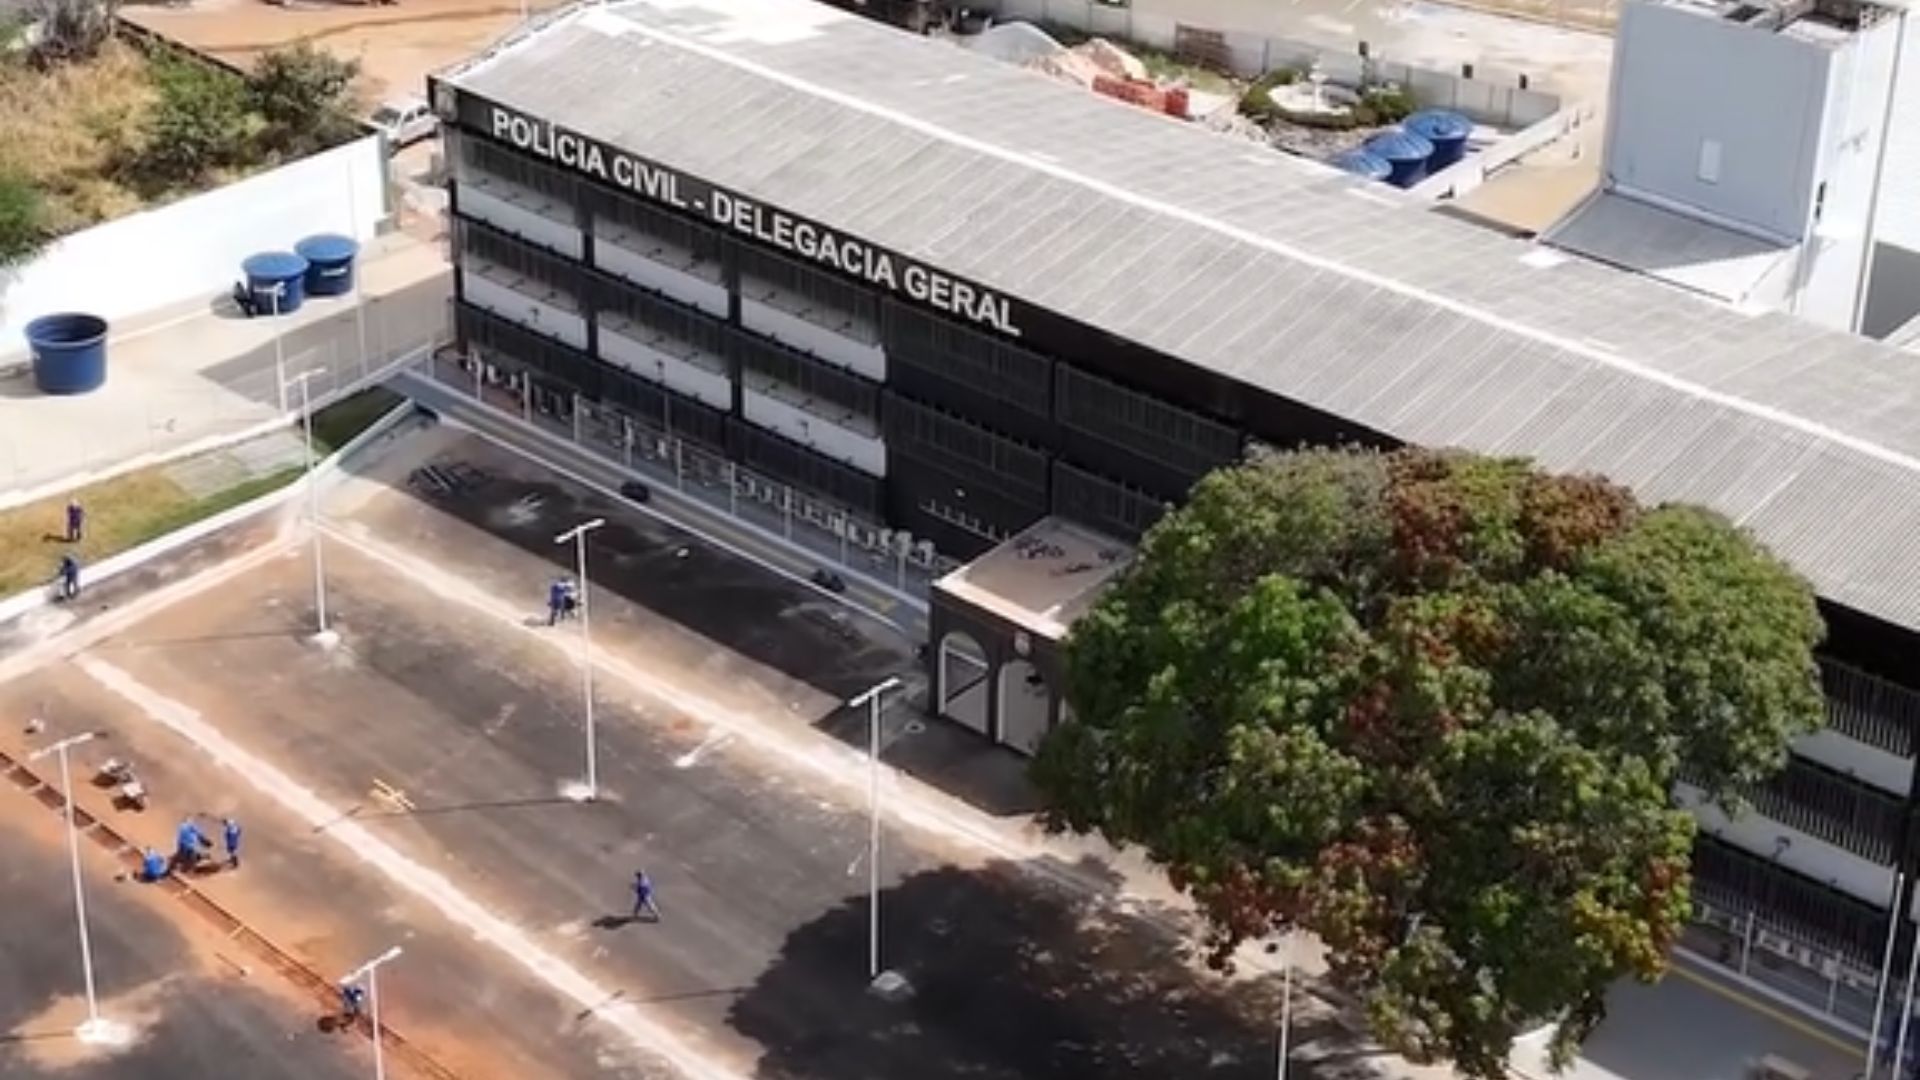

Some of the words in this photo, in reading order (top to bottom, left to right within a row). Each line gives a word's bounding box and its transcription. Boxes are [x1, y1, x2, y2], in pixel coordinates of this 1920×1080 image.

[613, 155, 687, 208] CIVIL
[712, 190, 897, 290] DELEGACIA
[904, 265, 1022, 337] GERAL
